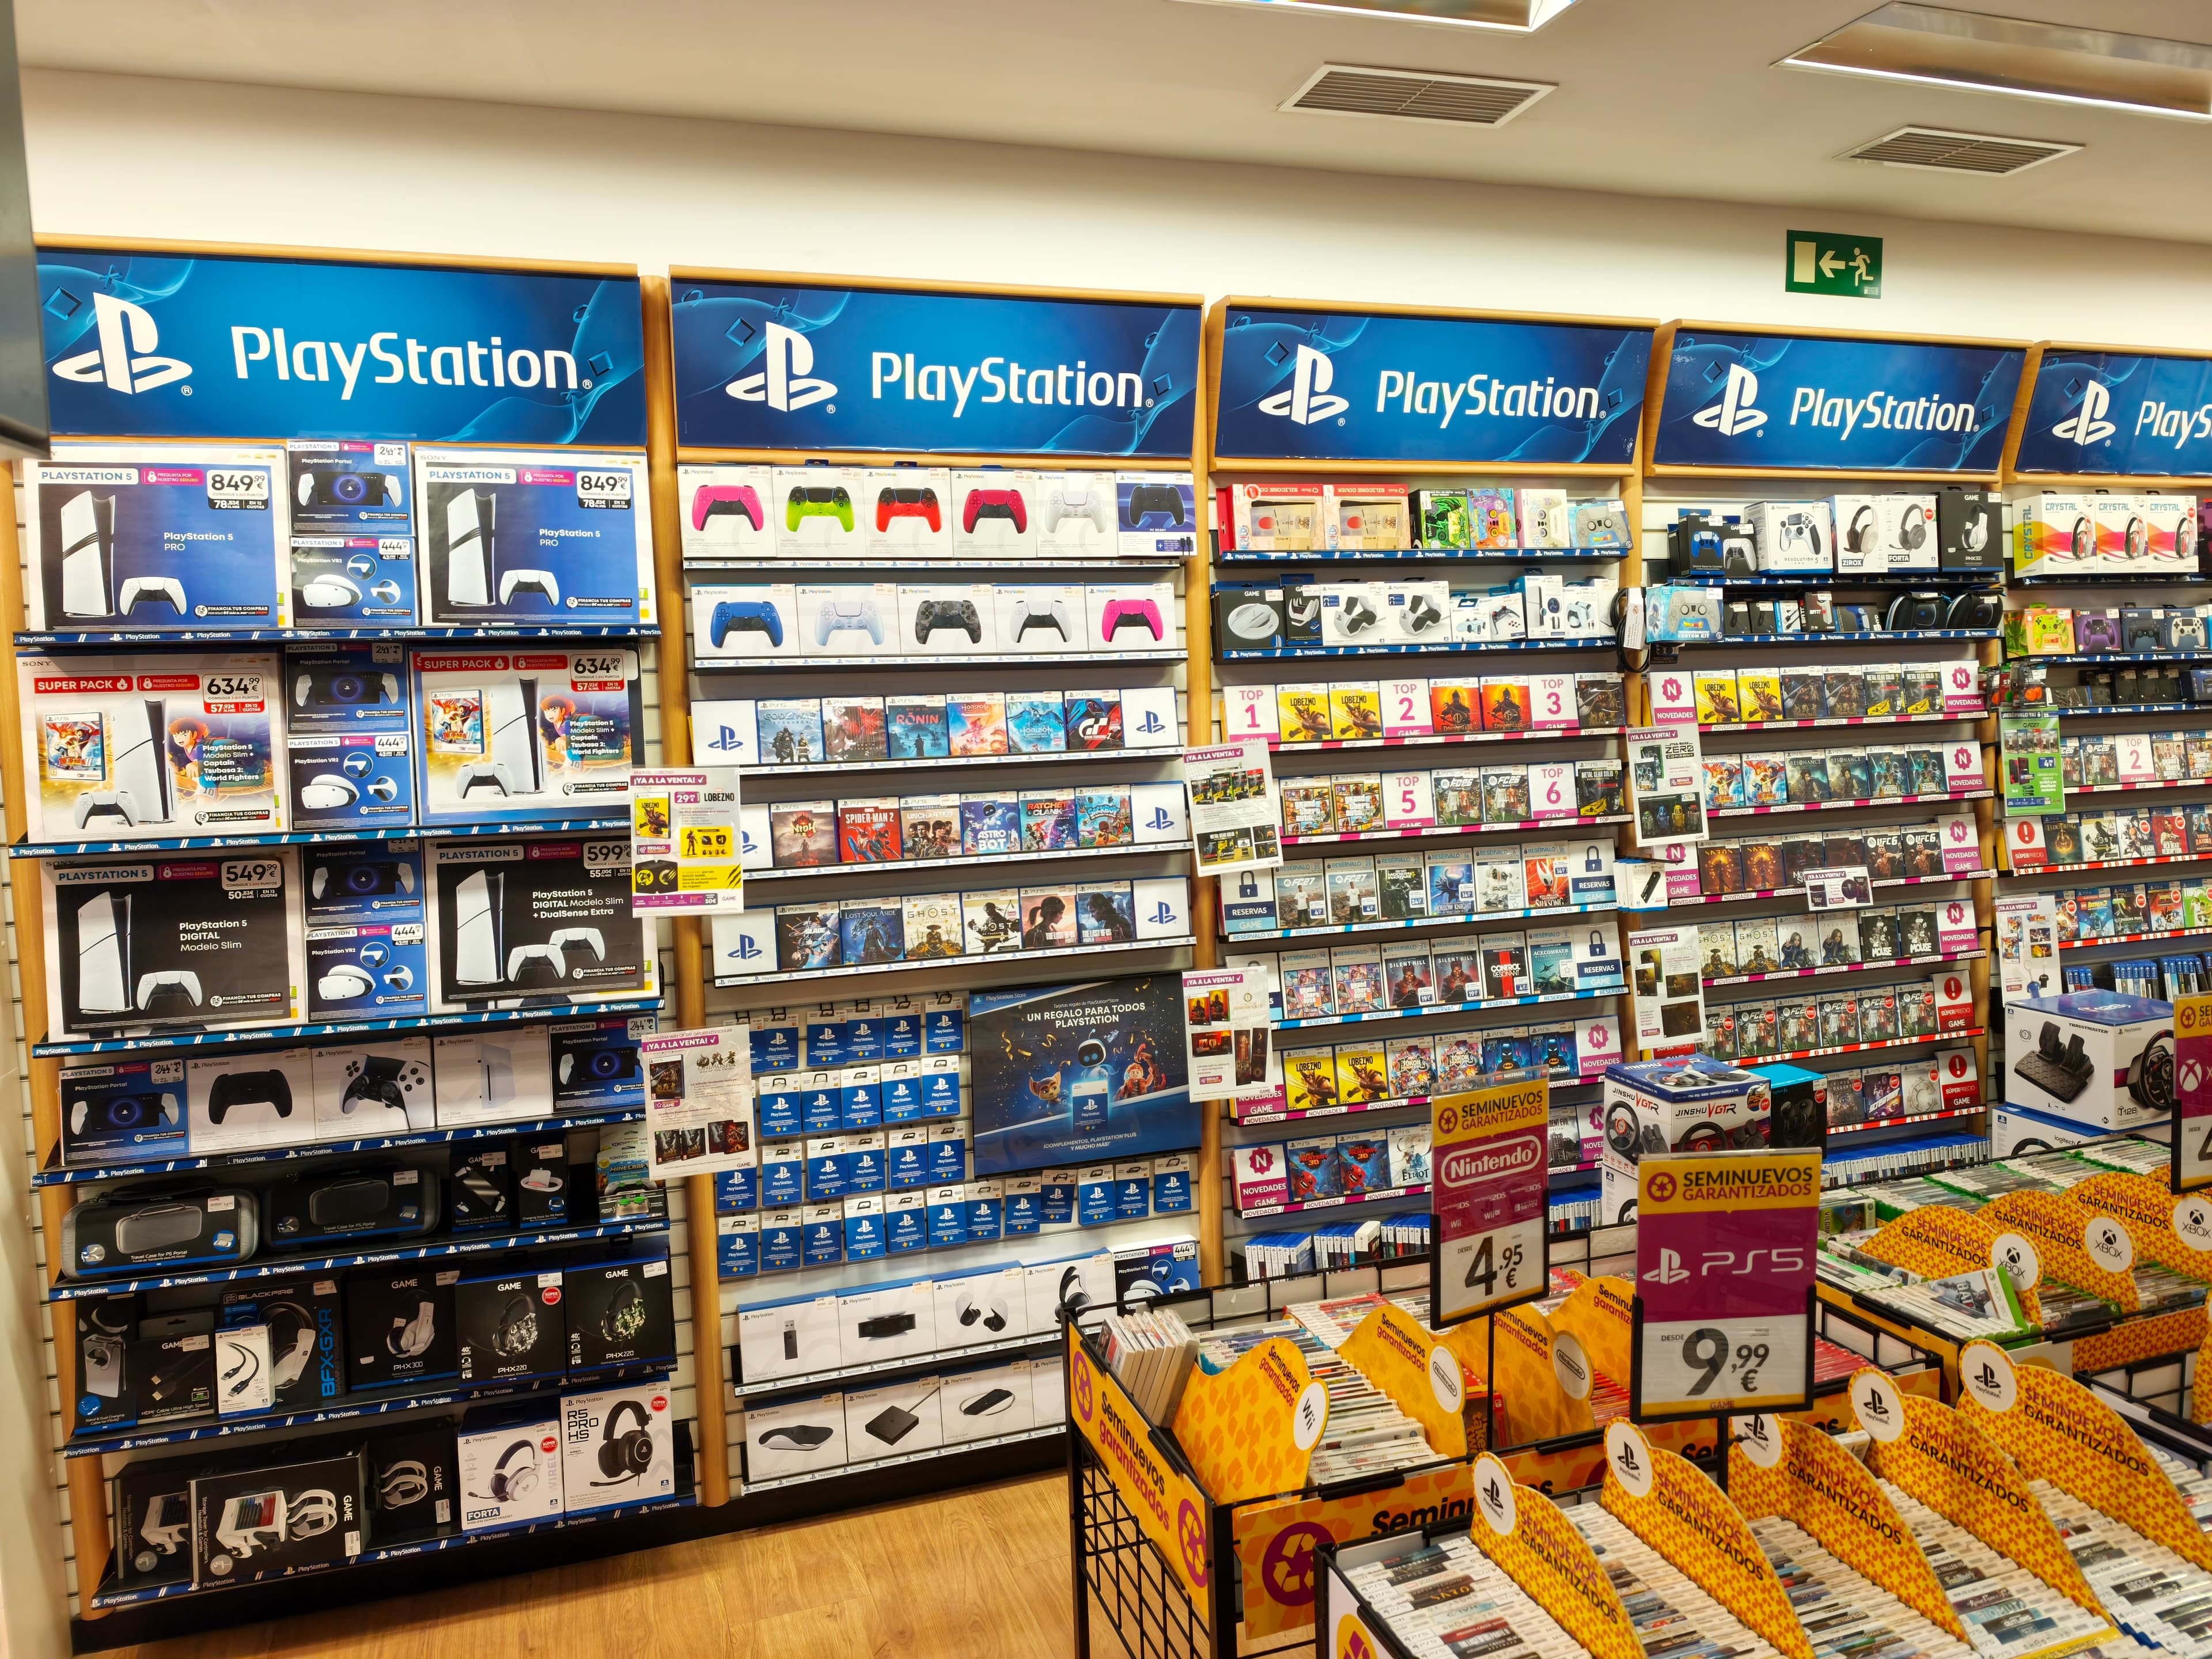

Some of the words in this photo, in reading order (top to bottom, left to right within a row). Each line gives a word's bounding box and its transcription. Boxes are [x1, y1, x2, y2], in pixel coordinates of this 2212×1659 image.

[231, 326, 578, 399] PlayStation
[872, 352, 1143, 417] PlayStation
[1377, 370, 1599, 429] PlayStation
[1790, 388, 1975, 440] PlayStation
[41, 471, 123, 481] PLAYSTATION
[126, 472, 132, 480] 5
[430, 471, 502, 480] PLAYSTATION
[164, 532, 225, 541] PlayStation
[540, 529, 593, 537] PlayStation
[165, 543, 185, 551] PRO
[540, 539, 558, 547] PRO
[425, 660, 459, 669] SUPER
[462, 660, 491, 668] PACK
[37, 681, 77, 690] SUPER
[81, 680, 112, 689] PACK
[1393, 684, 1417, 694] TOP
[1541, 680, 1563, 689] TOP
[1239, 691, 1263, 700] TOP
[1290, 698, 1316, 706] LOBEZNO
[1547, 692, 1561, 714] 3
[1399, 698, 1415, 721] 2
[1245, 704, 1260, 728] 1
[2125, 738, 2142, 747] TOP
[204, 759, 234, 767] Captain
[228, 774, 259, 782] Fighters
[1547, 782, 1561, 804] 6
[1028, 801, 1068, 810] RATCHET
[1402, 790, 1416, 813] 5
[1033, 808, 1063, 816] CLANK
[846, 813, 885, 824] SPIDER-MAN
[889, 813, 894, 822] 2
[978, 830, 1006, 839] ASTRO
[979, 839, 1006, 850] BOT
[440, 849, 510, 859] PLAYSTATION
[512, 849, 518, 857] 5
[1946, 851, 1978, 859] NOVEDADES
[59, 870, 139, 881] PLAYSTATION
[142, 870, 147, 878] 5
[533, 890, 584, 899] PlayStation
[533, 900, 568, 909] DIGITAL
[570, 899, 601, 907] Modelo
[605, 896, 623, 905] Slim
[1434, 904, 1450, 912] HOLLOW
[1452, 903, 1471, 911] KNIGHT
[540, 910, 588, 918] DualSense
[590, 908, 613, 916] Extra
[861, 911, 878, 919] SOUL
[1232, 908, 1267, 916] RESERVAS
[180, 921, 238, 931] PlayStation
[241, 919, 247, 927] 5
[180, 931, 219, 941] DIGITAL
[181, 942, 219, 952] Modelo
[221, 940, 242, 950] Slim
[1873, 947, 1892, 957] MOUSE
[1491, 963, 1521, 972] CONTROL
[1493, 969, 1520, 977] RESONANT
[1027, 1013, 1041, 1021] UN
[1044, 1009, 1082, 1020] REGALO
[1085, 1007, 1110, 1016] PARA
[1112, 1002, 1145, 1013] TODOS
[1056, 1014, 1119, 1028] PLAYSTATION
[2069, 1022, 2109, 1033] THRUSTMASTER
[1462, 1091, 1543, 1119] SEMINUEVOS
[1676, 1108, 1707, 1117] JINSHU
[2117, 1106, 2138, 1116] T128
[1462, 1104, 1543, 1131] GARANTIZADOS
[2054, 1135, 2075, 1146] logitech
[1451, 1147, 1532, 1178] Nintendo
[1683, 1167, 1813, 1187] SEMINUEVOS
[1243, 1184, 1286, 1195] NOVEDADES
[1683, 1184, 1812, 1200] GARANTIZADOS
[1450, 1219, 1461, 1228] Wii
[1458, 1245, 1473, 1253] DESDE
[1702, 1248, 1804, 1276] PS5
[605, 1270, 628, 1278] GAME
[238, 1289, 294, 1300] BLACKFIRE
[319, 1309, 335, 1396] BFX-GXR
[1268, 1344, 1301, 1395] Seminuevos
[1259, 1355, 1296, 1408] garantizados
[1741, 1369, 1758, 1392] €
[568, 1417, 598, 1431] PRO
[569, 1430, 589, 1441] HS
[1101, 1391, 1165, 1497] Seminuevos
[1910, 1417, 2006, 1481] SEMINUEVOS
[1099, 1419, 1171, 1532] garantizados
[1910, 1434, 2029, 1513] GARANTIZADOS
[468, 1508, 499, 1519] FORTA
[1657, 1472, 1743, 1546] SEMINUEVOS
[1657, 1491, 1764, 1581] GARANTIZADOS
[1521, 1510, 1599, 1586] SEMINUEVOS
[1521, 1529, 1619, 1626] GARANTIZADOS
